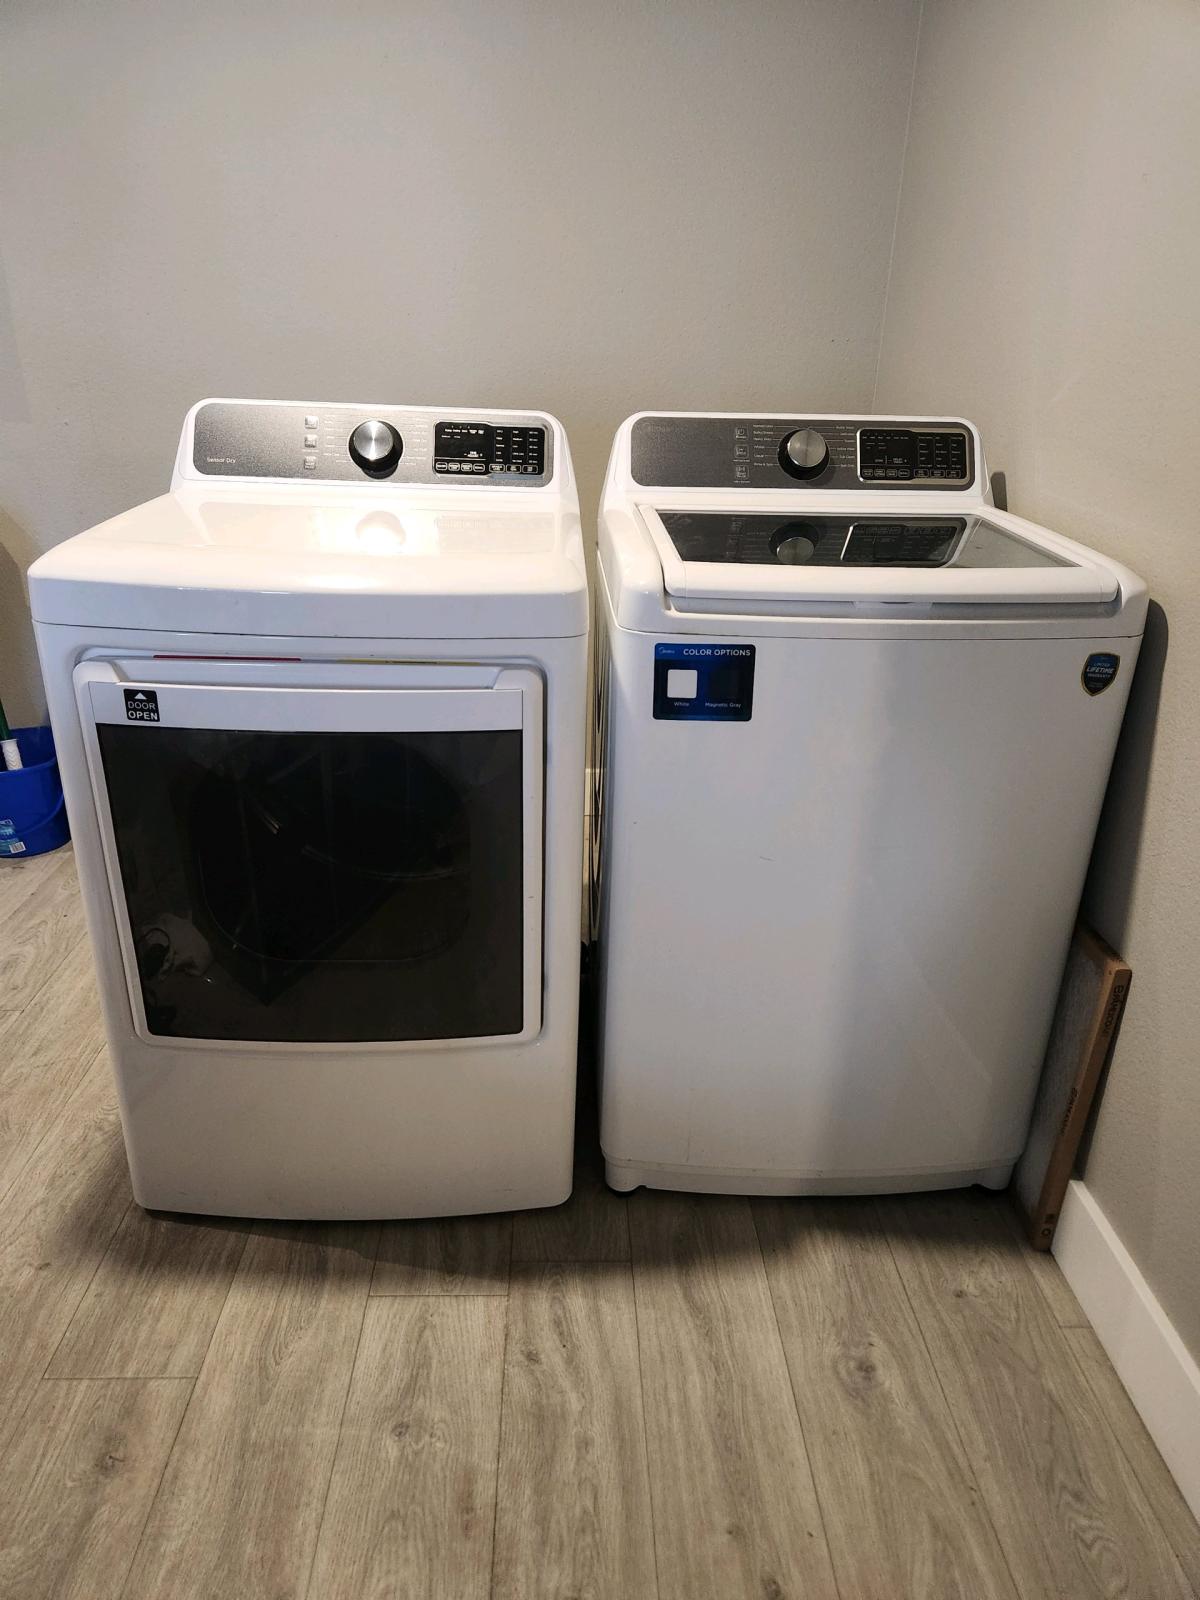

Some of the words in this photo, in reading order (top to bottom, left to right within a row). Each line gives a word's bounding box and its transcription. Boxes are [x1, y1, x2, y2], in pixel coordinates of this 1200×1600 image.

[683, 648, 712, 656] COLOR
[713, 648, 751, 657] OPTIONS
[127, 701, 156, 710] DOOR
[128, 710, 158, 720] OPEN
